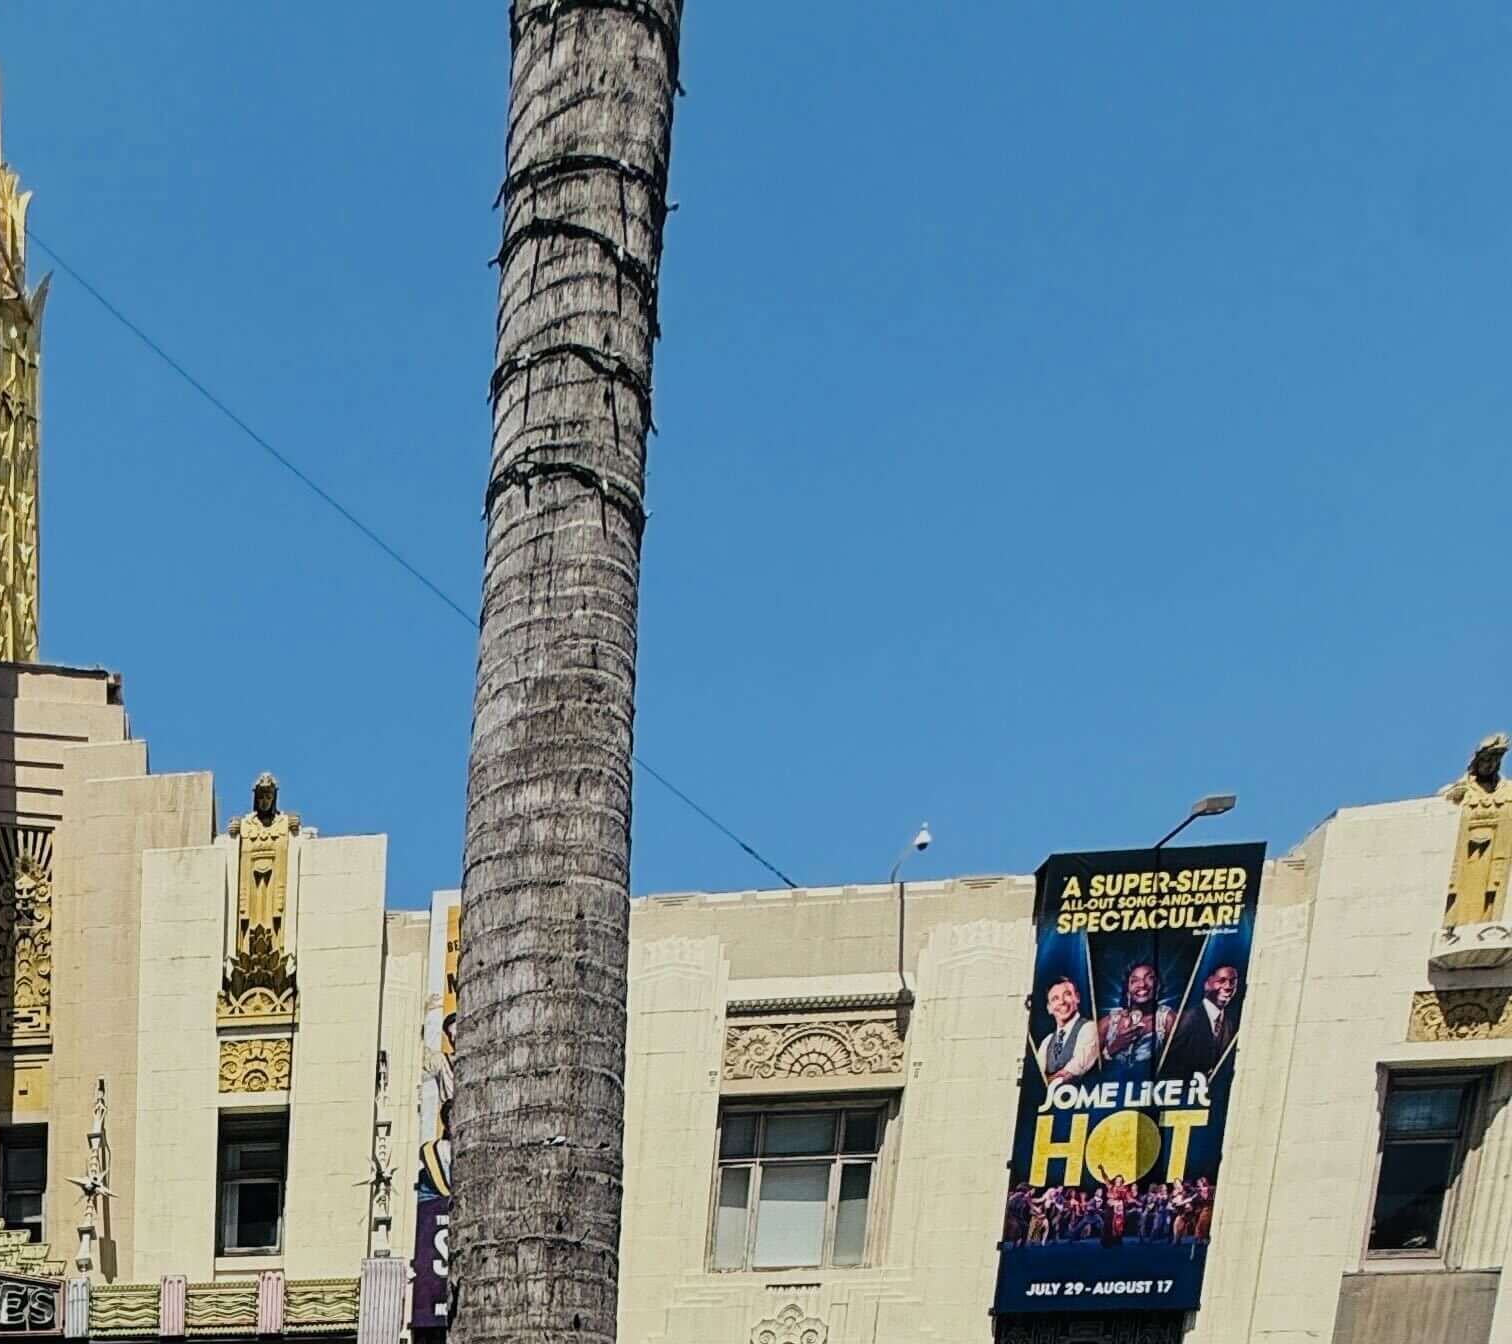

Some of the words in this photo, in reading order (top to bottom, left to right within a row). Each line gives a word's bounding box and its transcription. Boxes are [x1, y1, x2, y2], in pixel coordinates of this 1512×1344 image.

[1060, 898, 1115, 911] ALL-OUT
[1039, 1077, 1119, 1112] SOME
[1029, 1110, 1209, 1187] HOT
[1026, 1283, 1060, 1296] JULY
[1064, 1282, 1084, 1295] 29
[1092, 1280, 1153, 1294] AUGUST
[1157, 1280, 1173, 1293] 17
